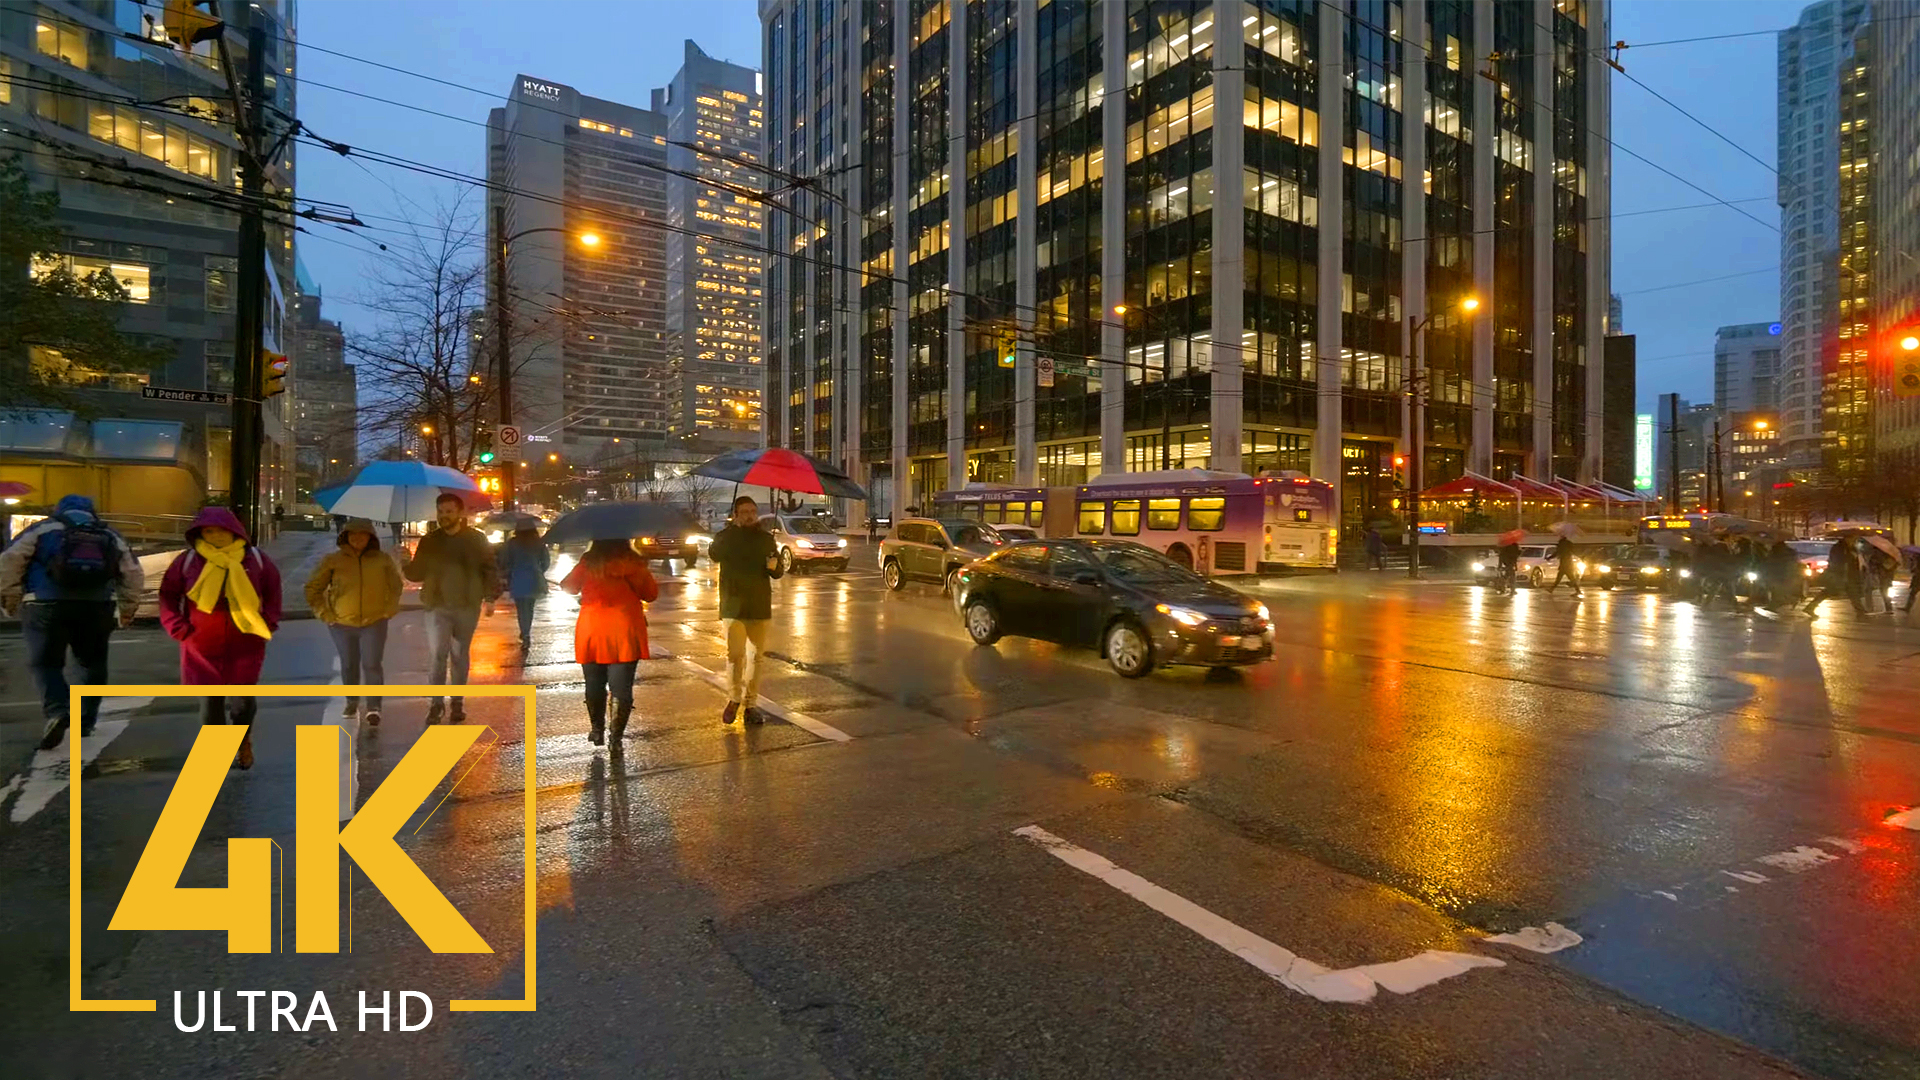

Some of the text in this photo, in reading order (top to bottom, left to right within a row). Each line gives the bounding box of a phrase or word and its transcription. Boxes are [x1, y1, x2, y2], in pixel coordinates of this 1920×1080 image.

[524, 80, 560, 96] HYATT
[524, 89, 560, 101] REGENCY
[145, 388, 155, 397] W
[158, 389, 195, 401] Pender
[1648, 520, 1659, 529] 32
